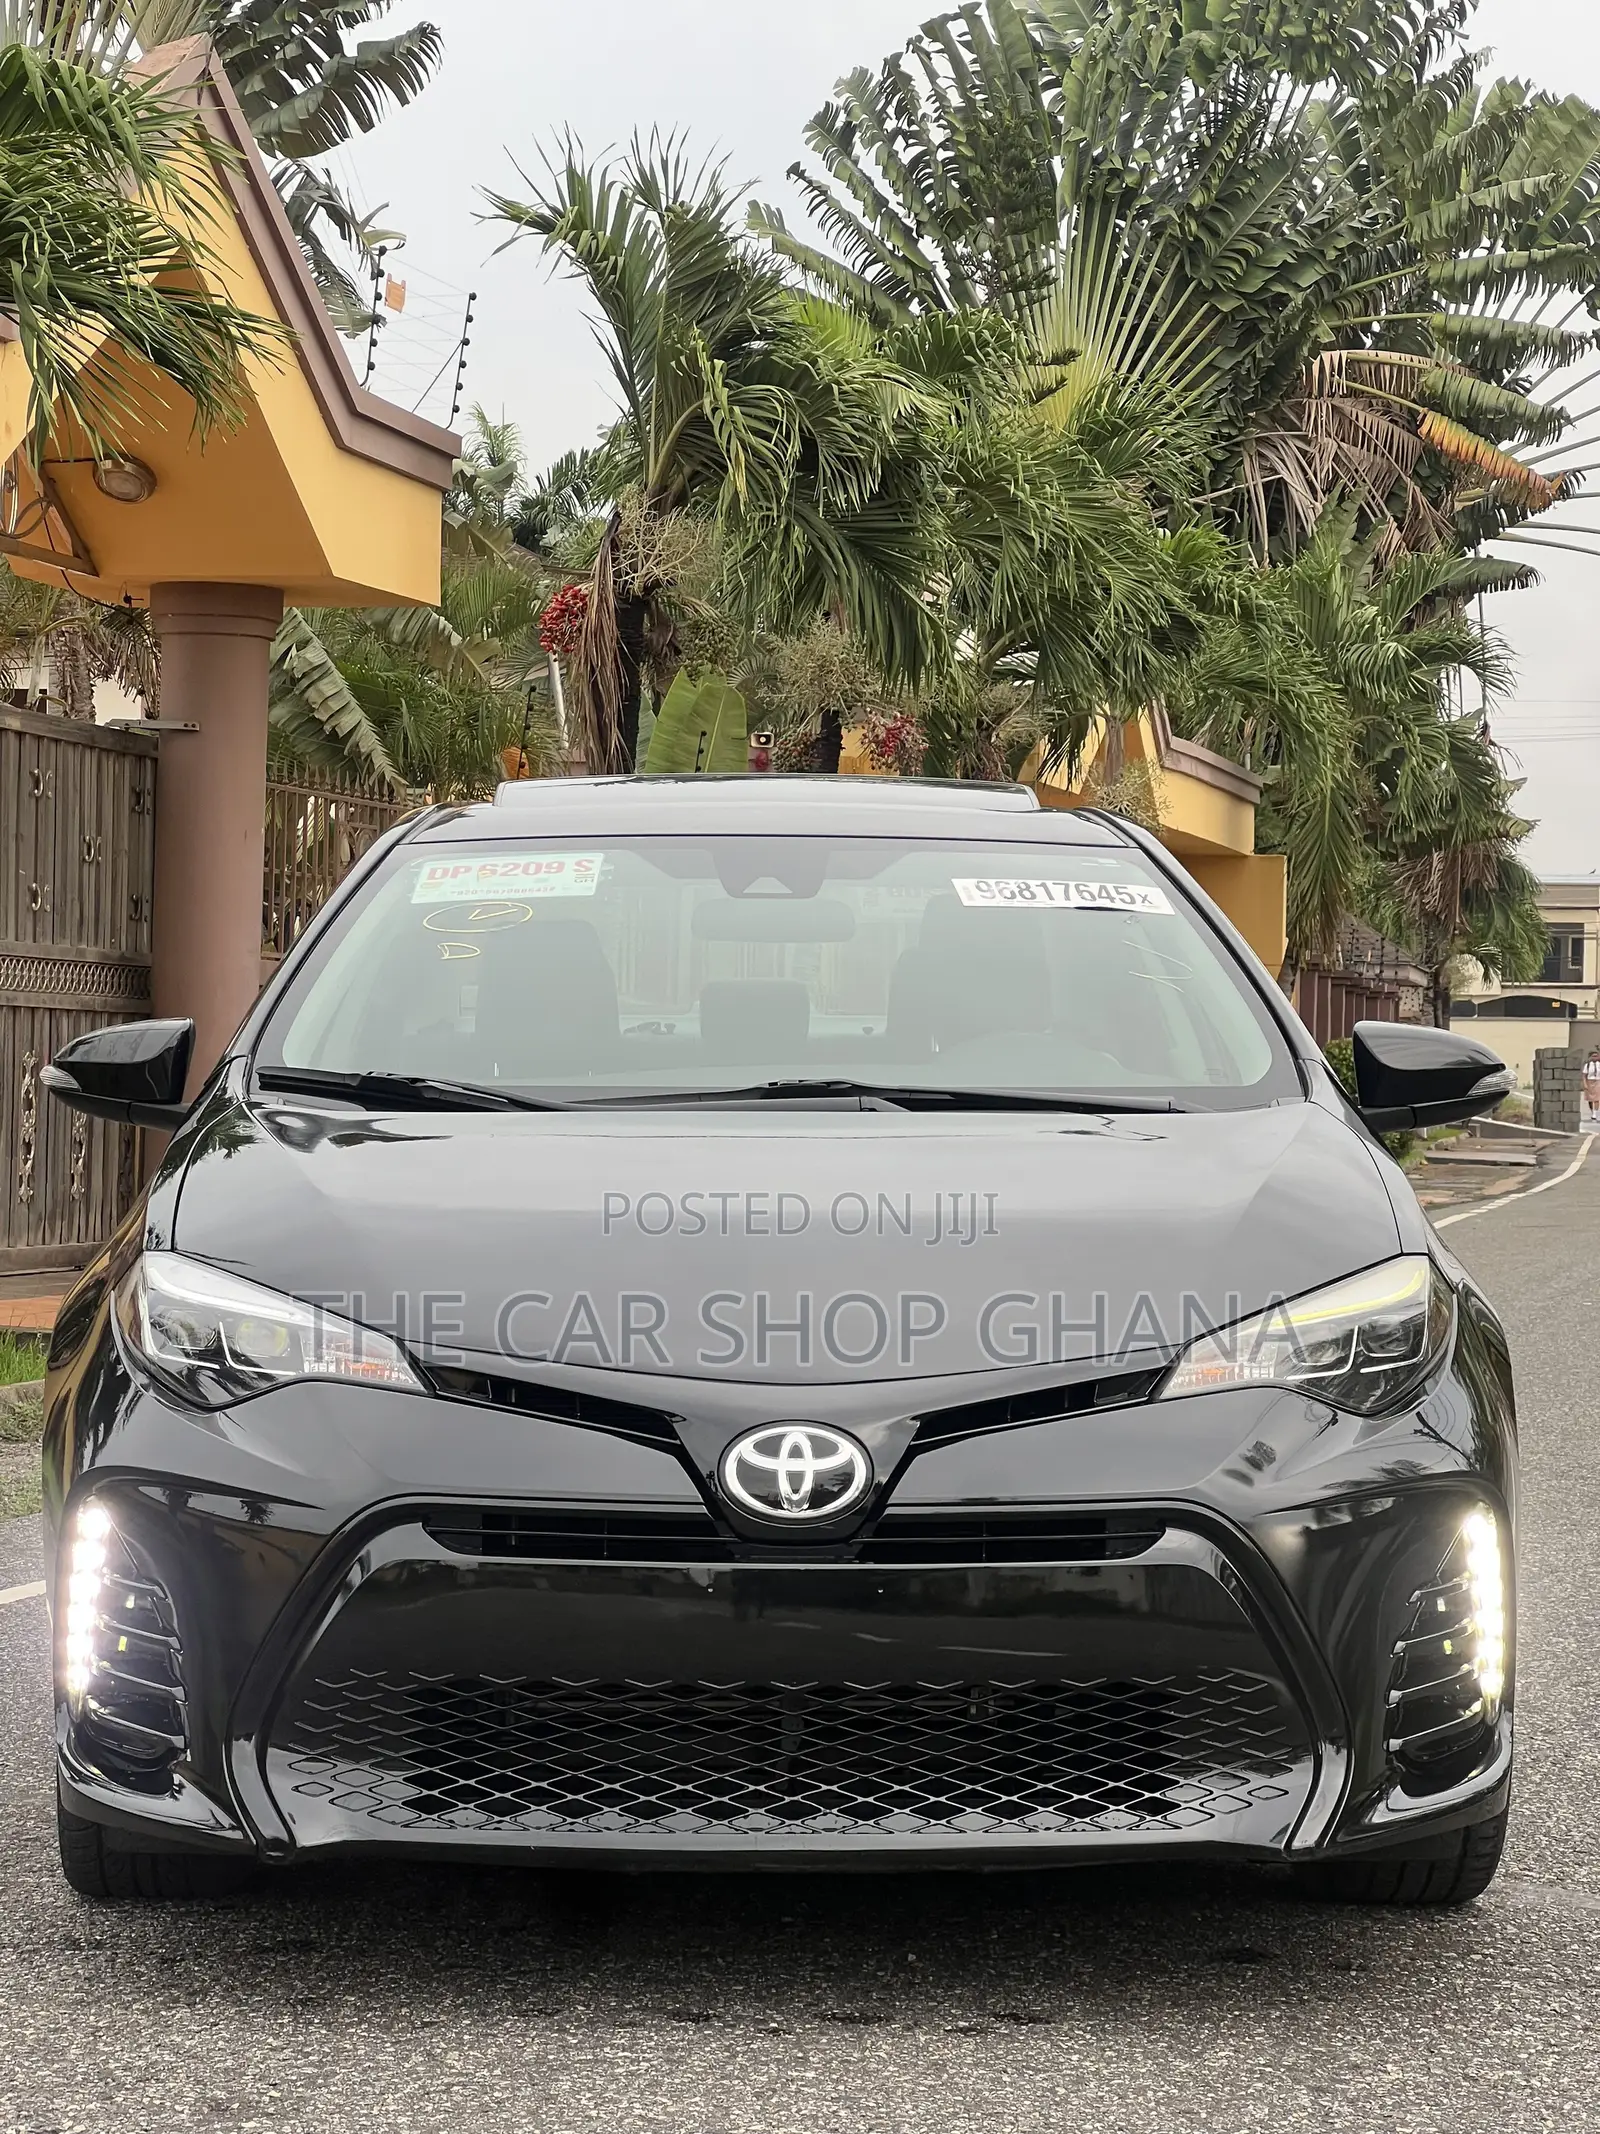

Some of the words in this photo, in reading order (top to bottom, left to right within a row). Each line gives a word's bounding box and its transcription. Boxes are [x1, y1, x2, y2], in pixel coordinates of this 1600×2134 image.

[428, 866, 473, 881] DP
[477, 861, 565, 880] 6209
[572, 859, 594, 873] S
